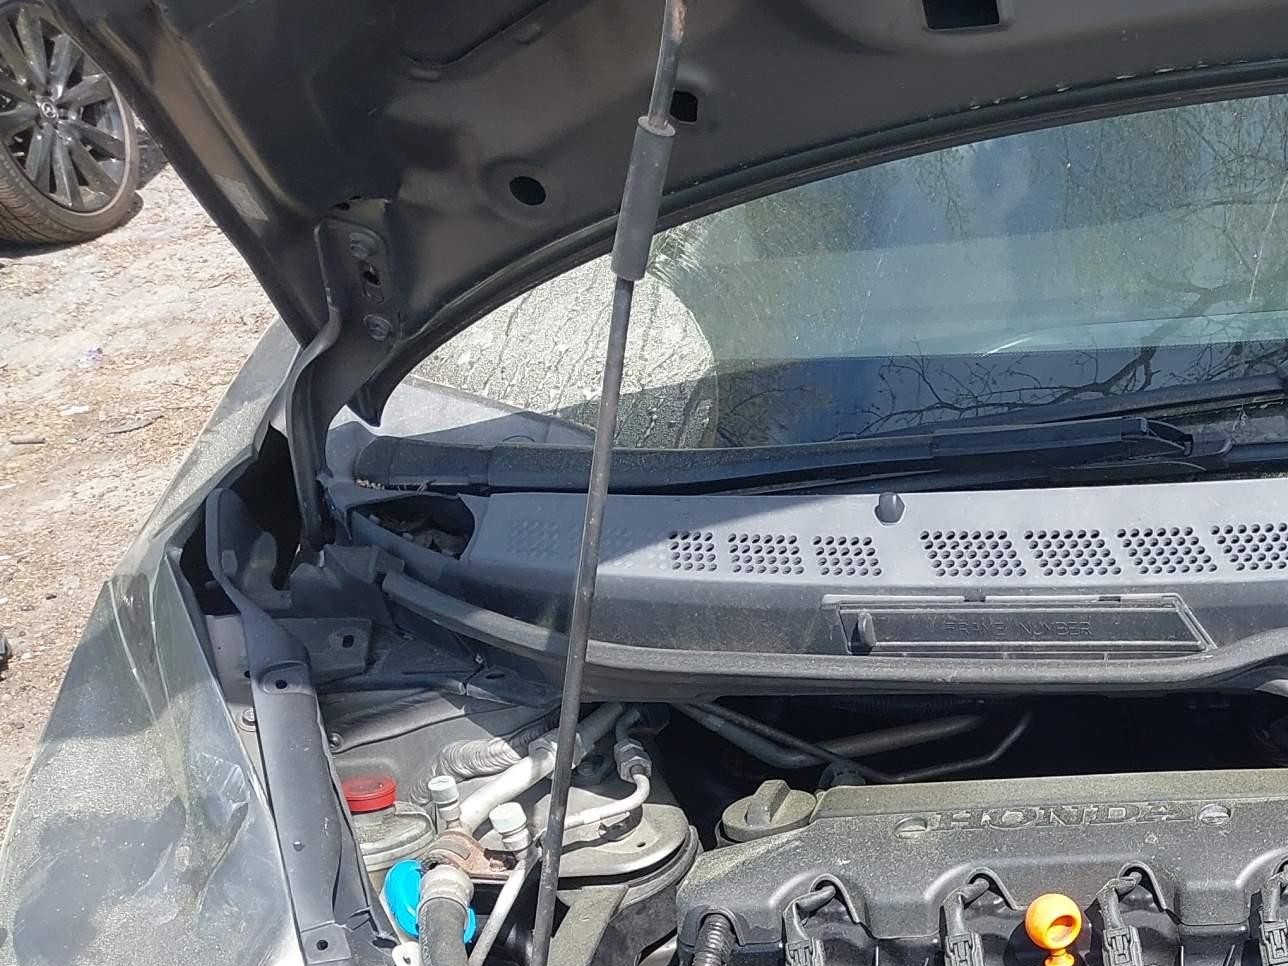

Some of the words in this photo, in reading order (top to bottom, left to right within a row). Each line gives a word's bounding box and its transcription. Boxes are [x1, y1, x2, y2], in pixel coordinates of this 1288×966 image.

[944, 620, 1007, 638] FRAME
[1017, 620, 1093, 637] NUMBER
[926, 802, 1198, 832] HONDA
